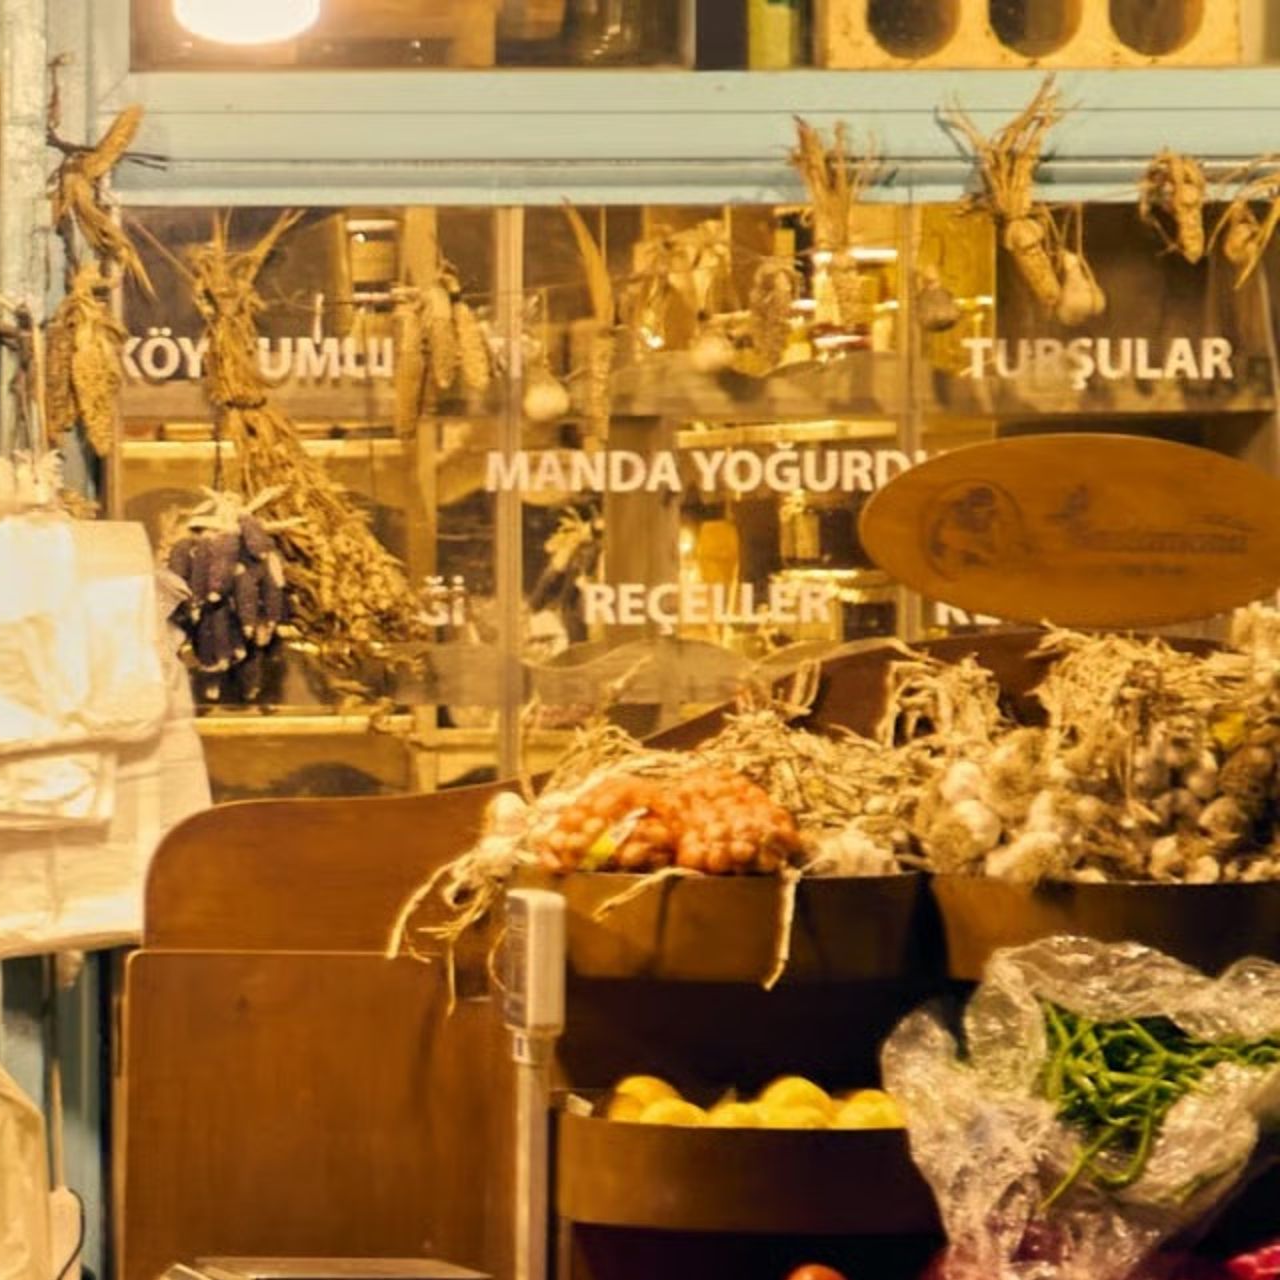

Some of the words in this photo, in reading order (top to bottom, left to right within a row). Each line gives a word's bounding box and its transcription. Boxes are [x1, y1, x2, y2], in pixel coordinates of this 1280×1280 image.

[960, 337, 1233, 390] TURŞULAR
[486, 450, 682, 492] MANDA
[692, 442, 928, 492] YOĞURD
[583, 582, 832, 635] REÇELLER
